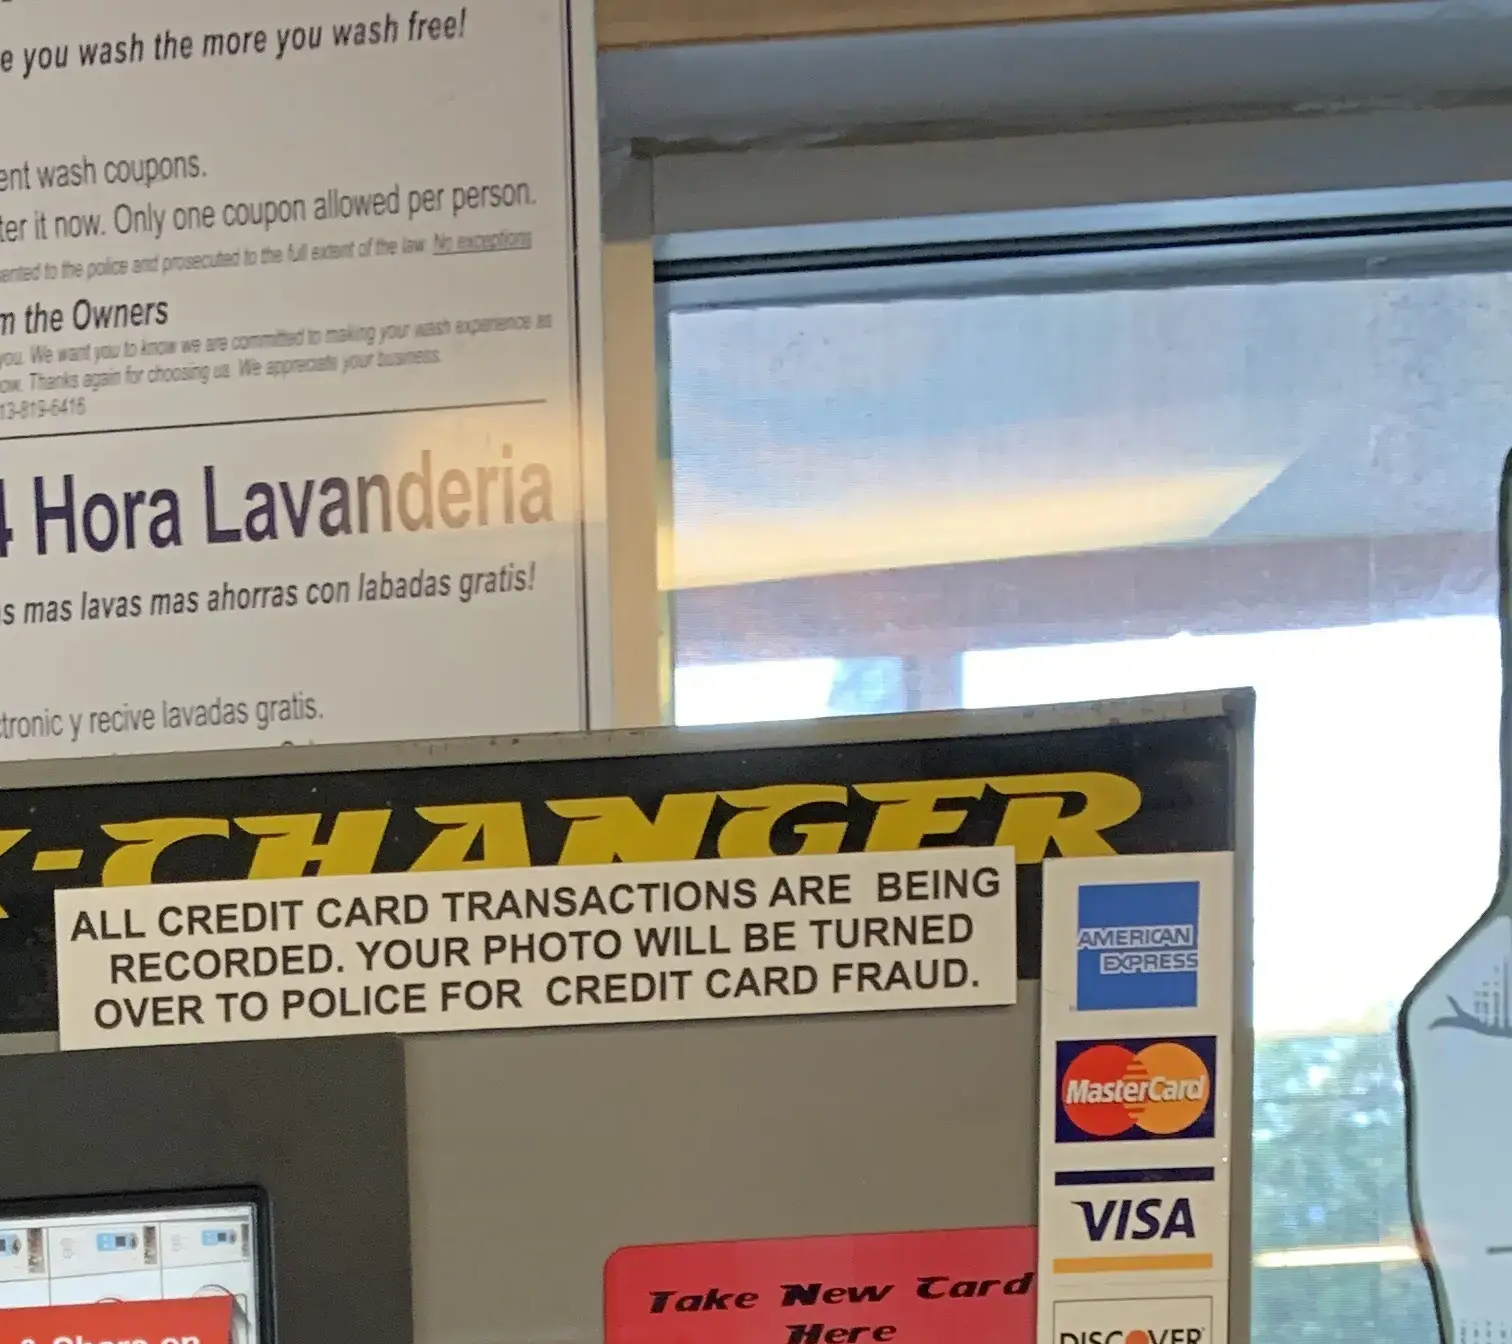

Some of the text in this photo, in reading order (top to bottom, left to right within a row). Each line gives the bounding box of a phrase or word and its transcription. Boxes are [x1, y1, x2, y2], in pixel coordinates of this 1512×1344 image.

[22, 44, 68, 80] you
[78, 31, 144, 66] wash
[154, 29, 193, 61] the
[202, 29, 267, 56] more
[274, 25, 322, 60] you
[332, 12, 399, 46] wash
[407, 6, 466, 41] free!
[35, 155, 97, 189] wash
[112, 201, 166, 240] Only
[172, 204, 215, 231] one
[221, 198, 306, 232] coupon
[313, 183, 400, 221] allowed
[407, 187, 445, 221] per
[24, 301, 64, 335] the
[72, 298, 170, 331] Owners
[33, 473, 183, 556] Hora
[203, 443, 554, 544] Lavanderia
[23, 599, 73, 624] mas
[80, 590, 142, 620] lavas
[149, 590, 199, 616] mas
[207, 581, 298, 612] ahorras
[305, 580, 350, 605] con
[357, 568, 451, 601] labadas
[458, 560, 535, 603] gratis!
[89, 702, 155, 734] recive
[161, 696, 249, 729] lavadas
[69, 866, 1000, 942] ALL CREDIT CARD TRANSACTIONS ARE BEING
[110, 912, 973, 984] RECORDED. YOUR PHOTO WILL BE TURNED
[1077, 924, 1192, 948] AMERICAN
[1101, 951, 1200, 974] EXPRESS
[93, 957, 979, 1030] OVER TO POLICE FOR CREDIT CARD FRAUD.
[1064, 1075, 1206, 1106] MasterCard
[1071, 1198, 1197, 1242] VISA
[648, 1271, 1036, 1314] Take New Card
